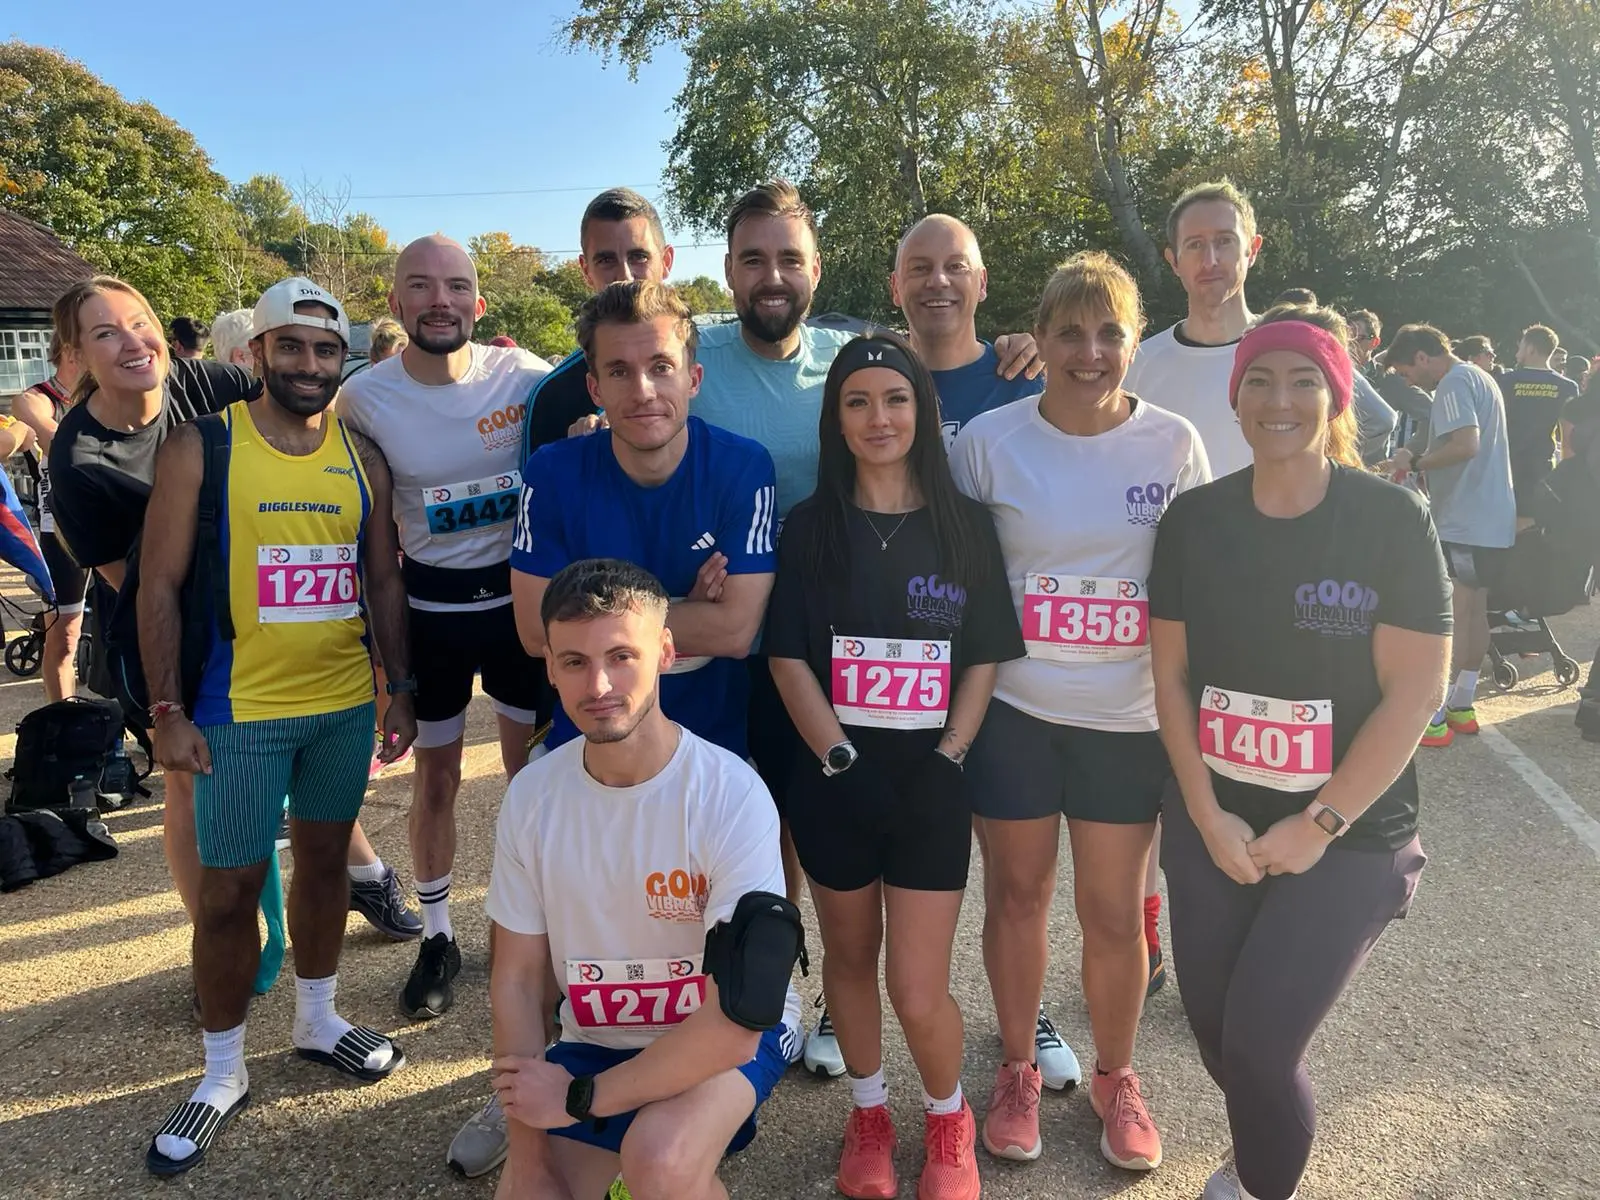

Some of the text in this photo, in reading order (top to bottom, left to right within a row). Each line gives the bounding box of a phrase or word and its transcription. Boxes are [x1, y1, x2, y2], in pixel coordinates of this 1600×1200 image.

[1514, 383, 1558, 391] SHEFFORD
[1515, 390, 1559, 398] RUNNERS
[258, 502, 342, 515] BIGGLESWADE
[435, 493, 520, 532] 3442
[268, 567, 354, 604] 1276
[1295, 579, 1379, 612] GOOD
[1033, 600, 1141, 643] 1358
[840, 664, 943, 708] 1275
[1206, 717, 1314, 770] 1401
[581, 982, 702, 1025] 1274
